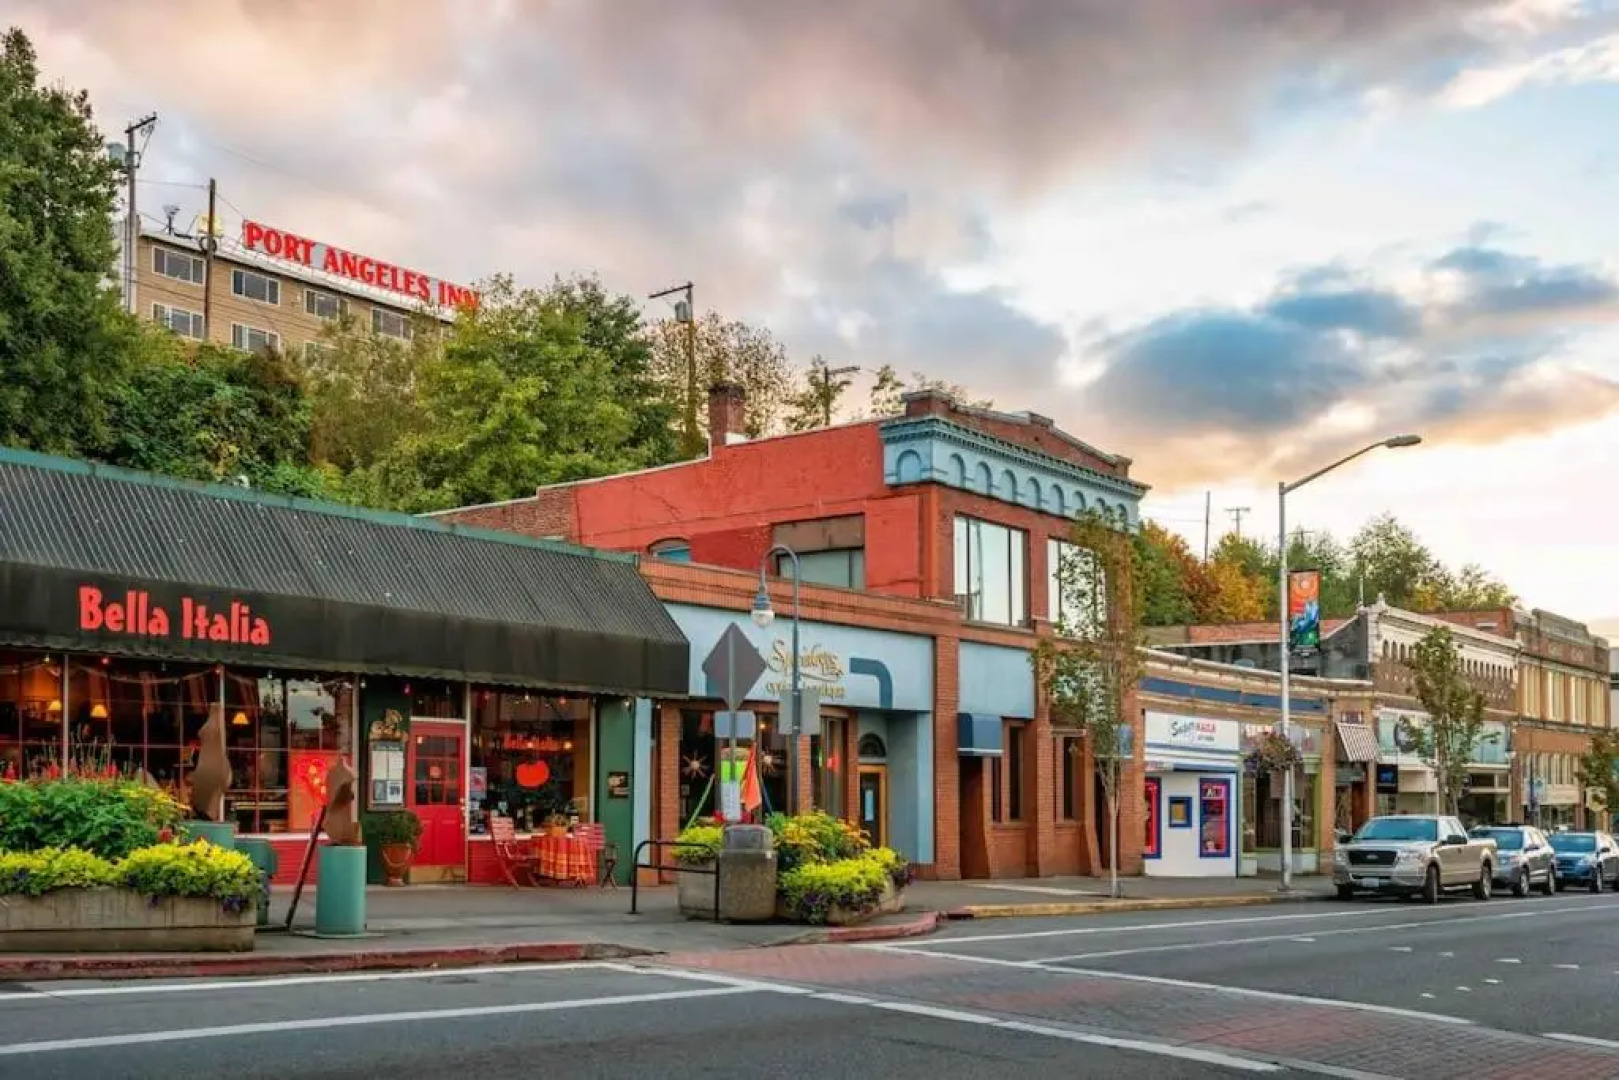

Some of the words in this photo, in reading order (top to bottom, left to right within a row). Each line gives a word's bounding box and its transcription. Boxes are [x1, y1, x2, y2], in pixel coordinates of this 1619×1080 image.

[244, 220, 316, 264] PORT
[323, 245, 430, 299] ANGELES
[438, 279, 480, 308] INN
[79, 585, 170, 636] Bella
[182, 598, 271, 645] Italia
